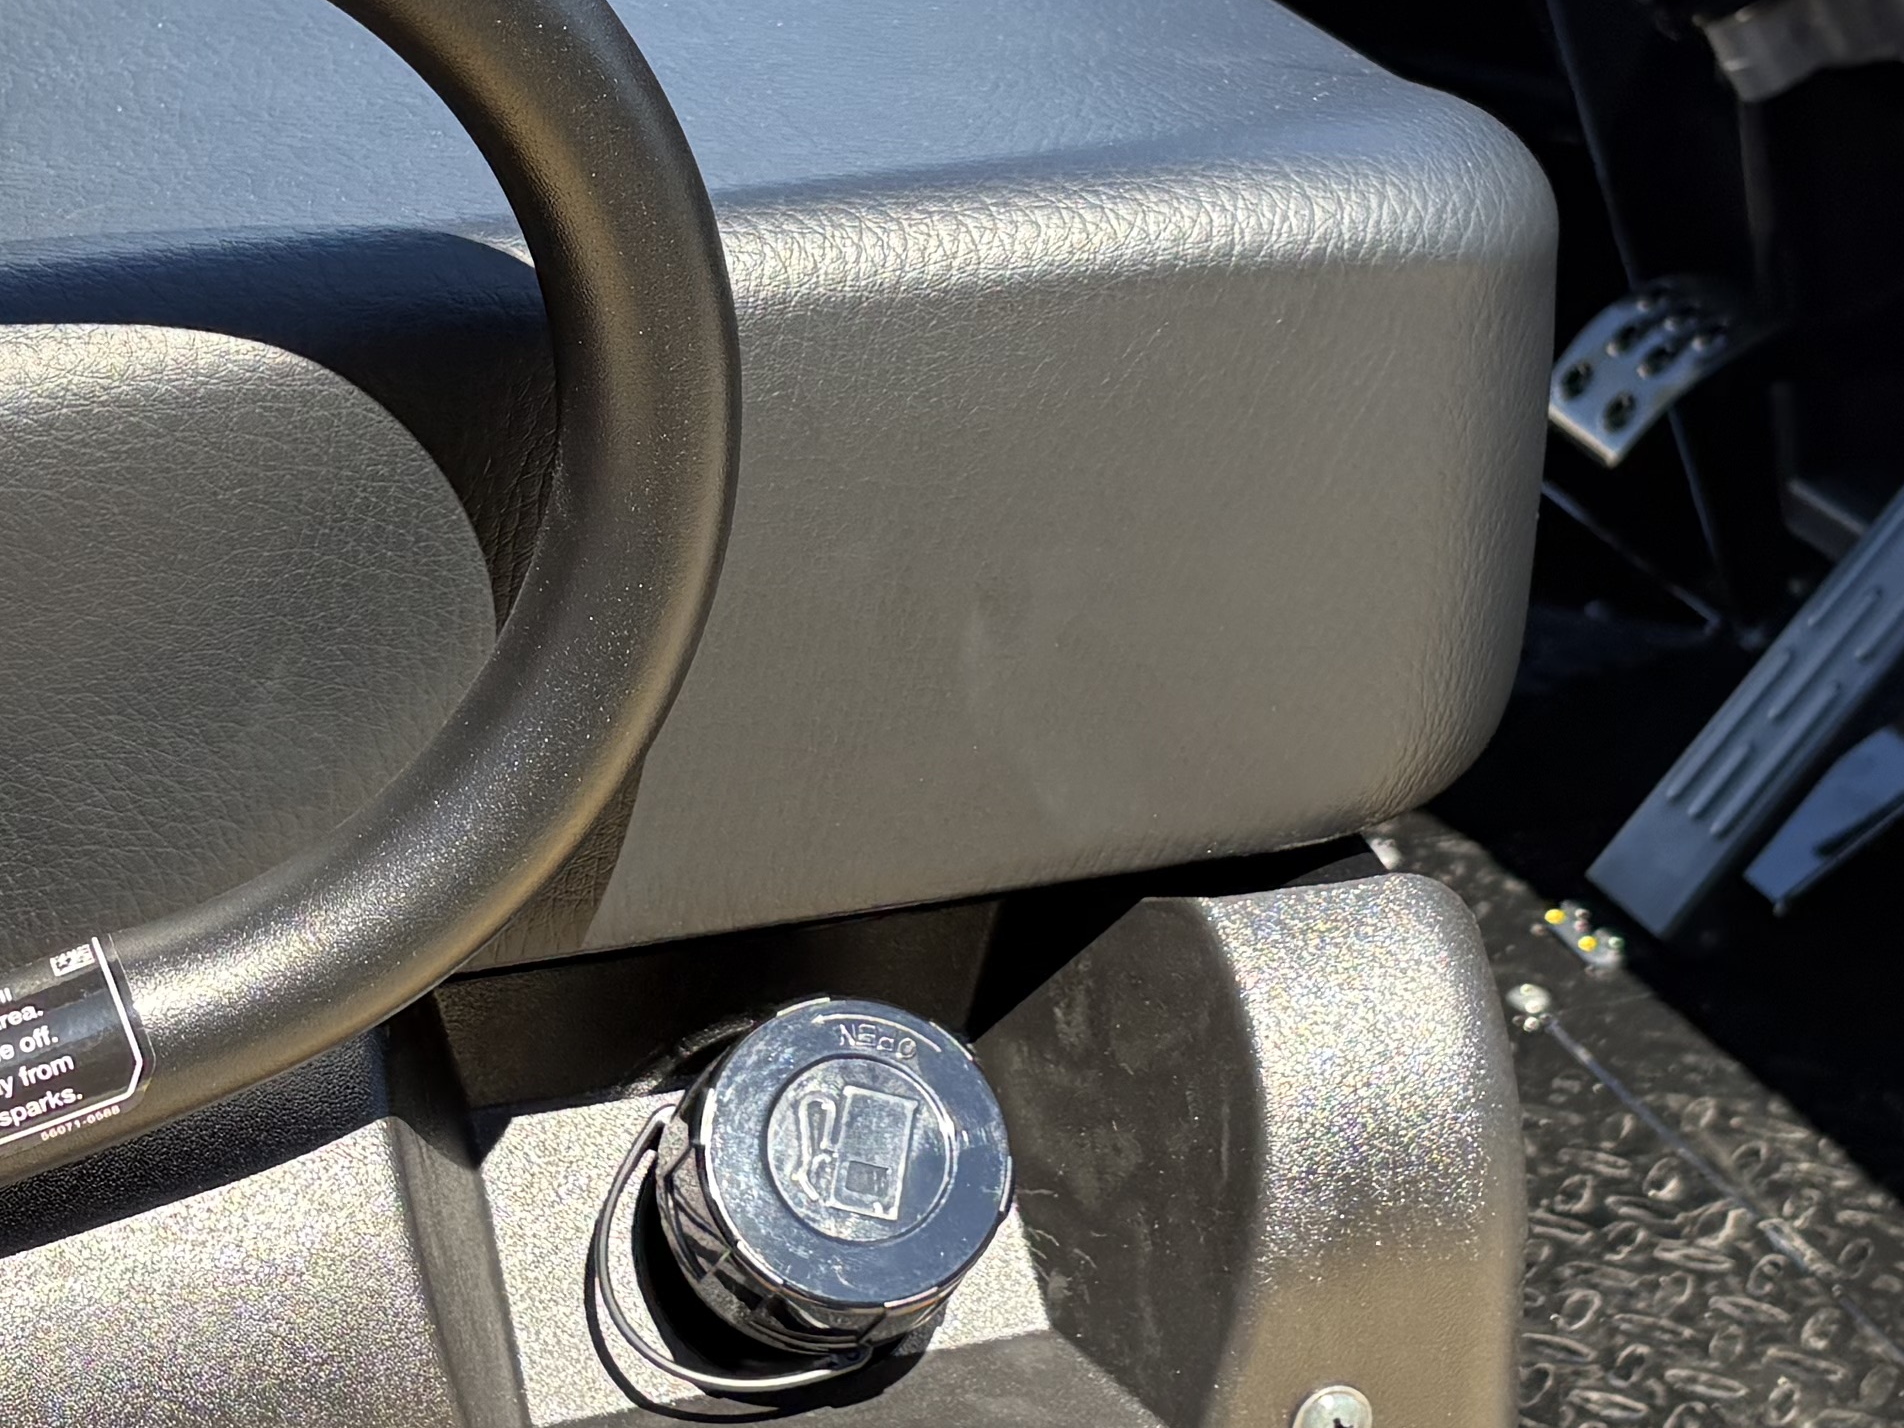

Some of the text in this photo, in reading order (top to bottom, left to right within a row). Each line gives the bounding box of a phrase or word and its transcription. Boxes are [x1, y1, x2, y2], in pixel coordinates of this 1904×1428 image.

[19, 1025, 59, 1055] off.
[837, 1022, 918, 1061] OPEN
[17, 1052, 75, 1087] from
